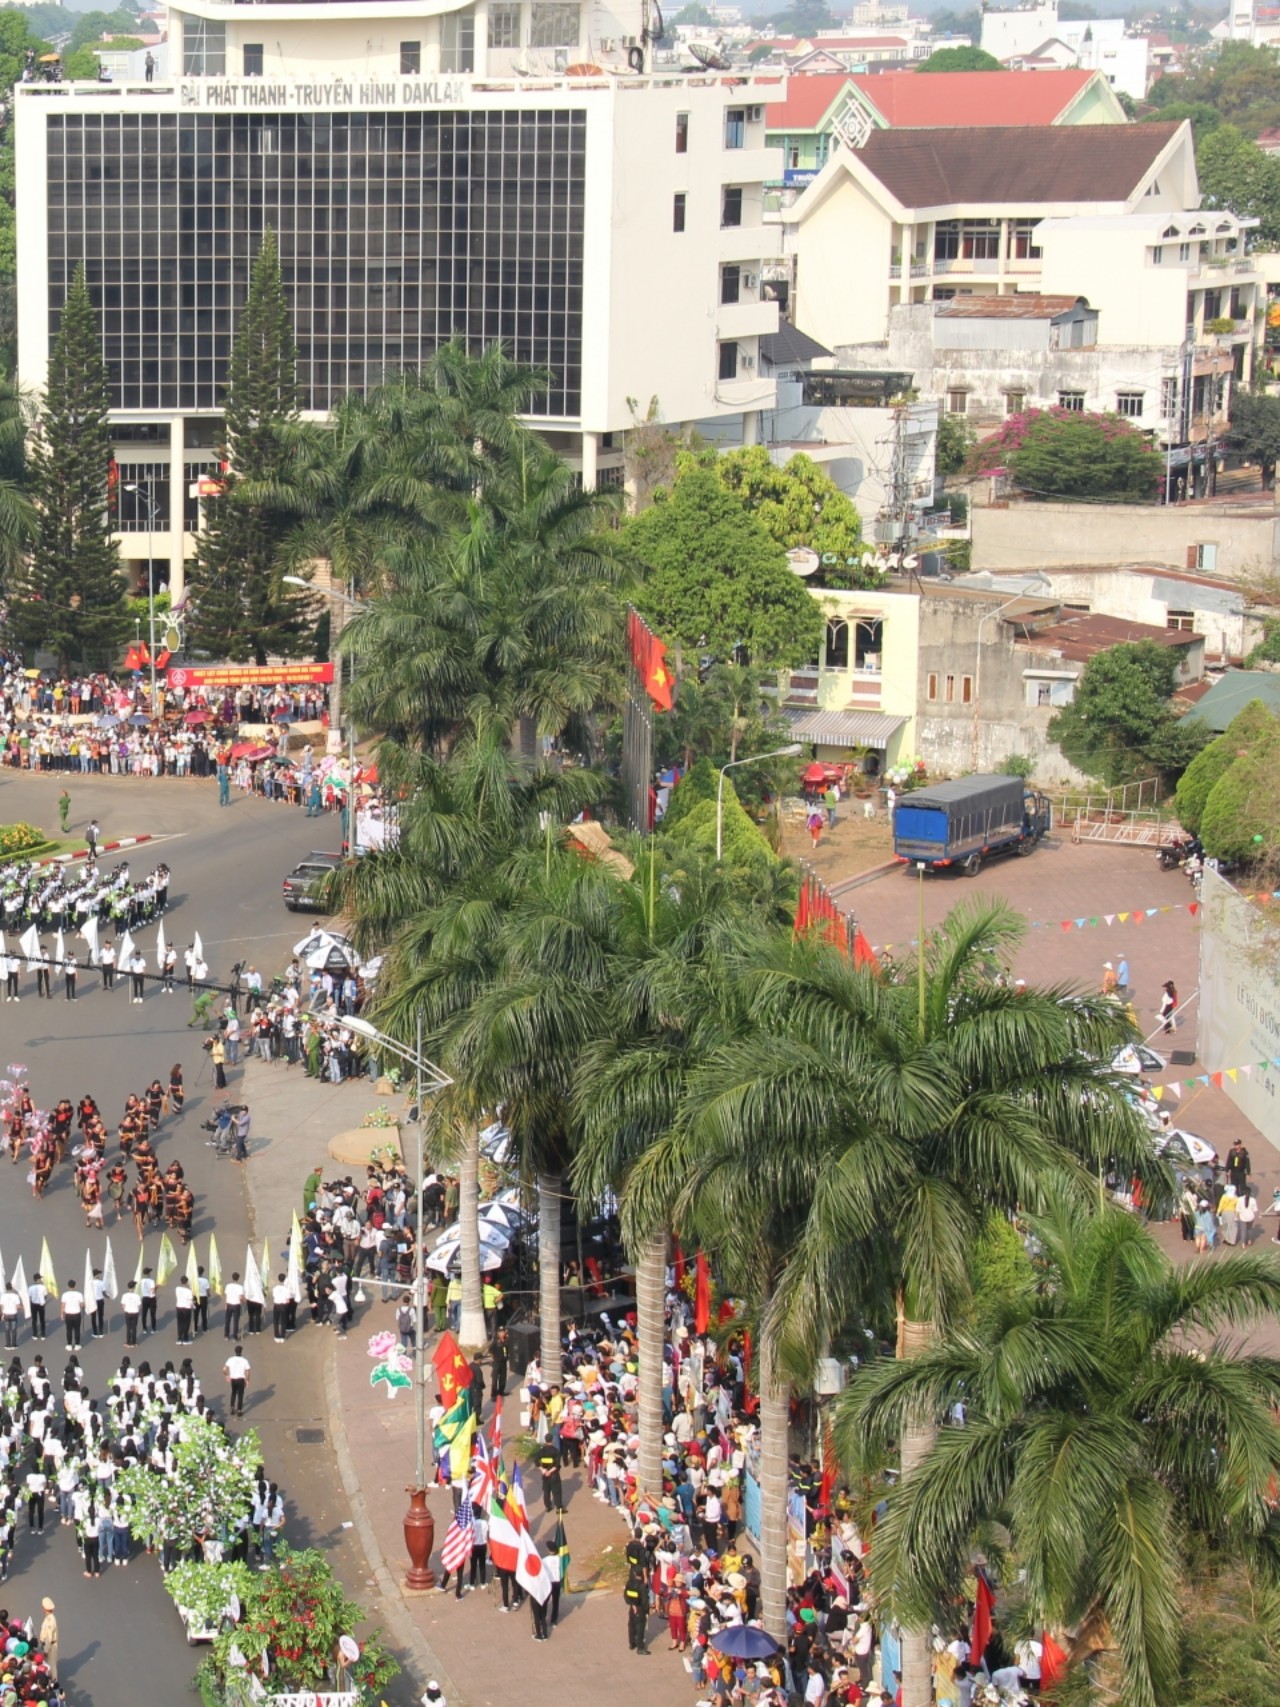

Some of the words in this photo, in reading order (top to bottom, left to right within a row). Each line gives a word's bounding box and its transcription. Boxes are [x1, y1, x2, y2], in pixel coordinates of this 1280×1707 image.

[206, 80, 239, 106] PHÁT
[241, 84, 287, 106] THANH
[295, 77, 353, 106] TRUYỀN
[359, 78, 396, 105] HÌNH
[902, 553, 918, 569] 6
